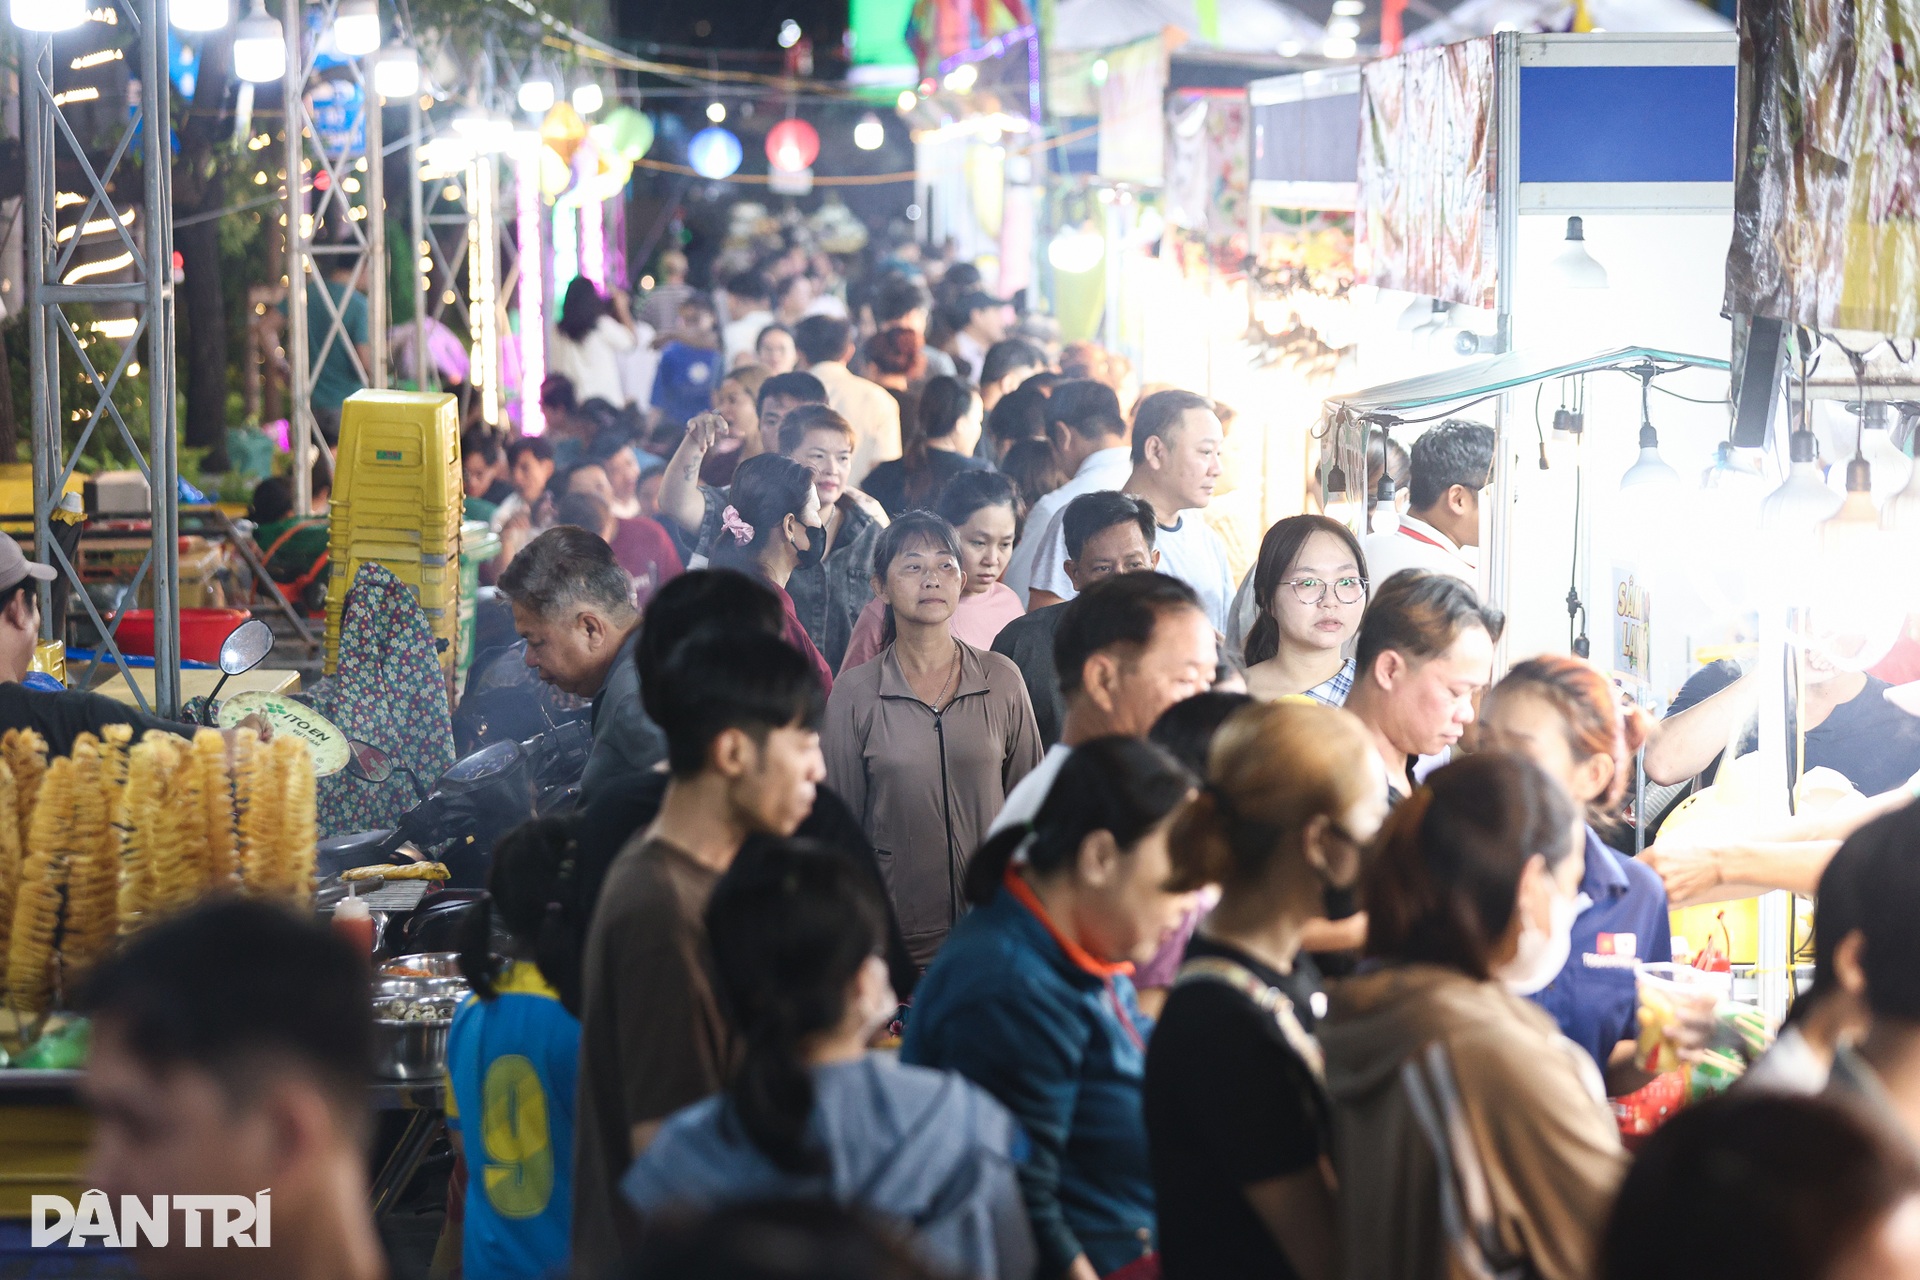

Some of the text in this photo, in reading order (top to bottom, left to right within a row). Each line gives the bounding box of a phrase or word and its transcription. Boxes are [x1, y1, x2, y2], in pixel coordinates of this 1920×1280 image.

[283, 713, 331, 741] ITO EN
[484, 1053, 555, 1219] 9
